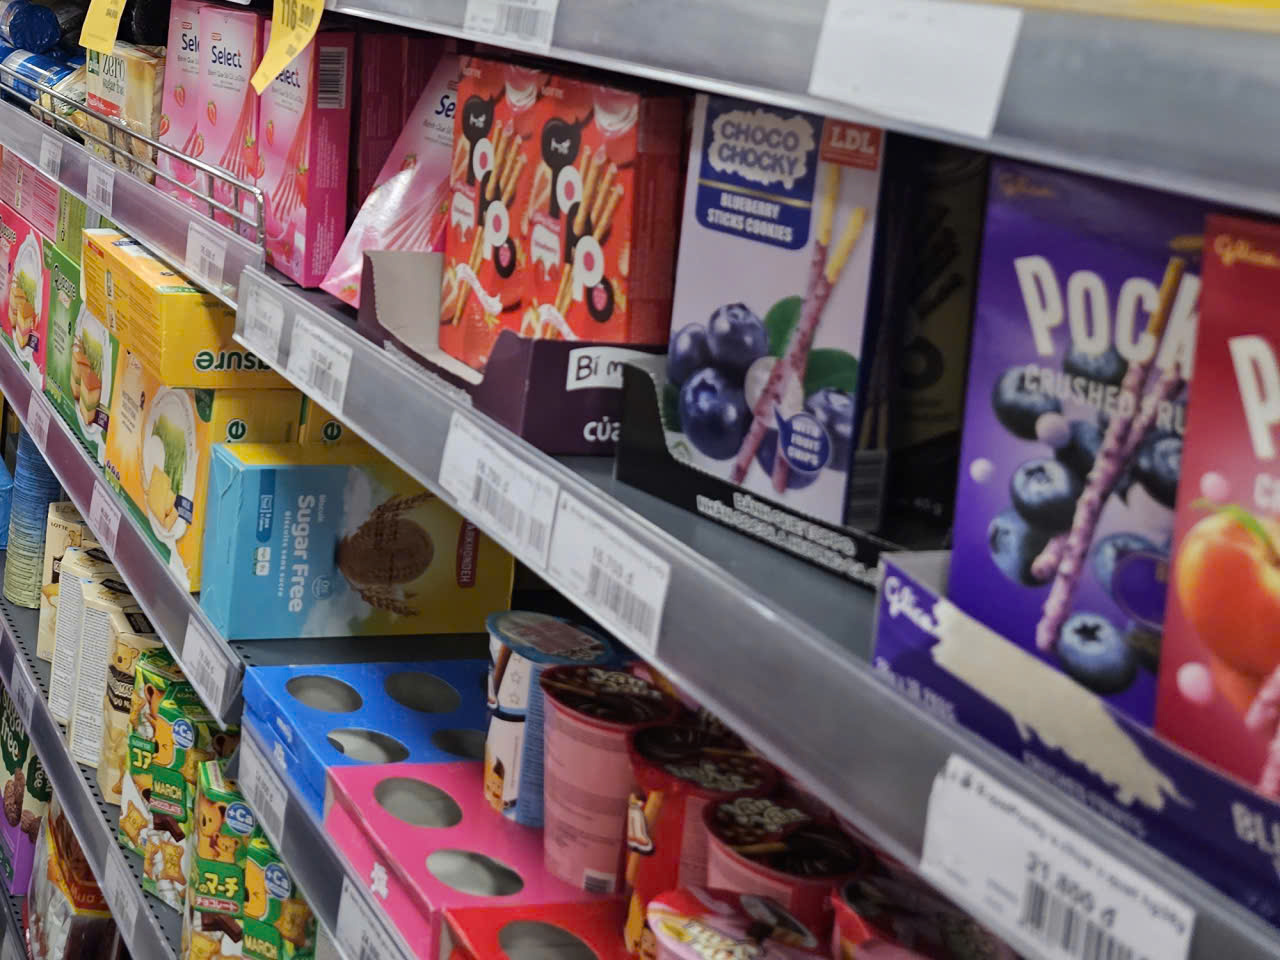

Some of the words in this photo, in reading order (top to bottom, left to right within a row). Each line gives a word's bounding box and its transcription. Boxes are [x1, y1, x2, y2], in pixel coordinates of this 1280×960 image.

[181, 33, 199, 52] Sel
[103, 54, 126, 81] zero
[211, 45, 242, 69] Select
[721, 120, 800, 153] CHOCO
[831, 126, 876, 154] LDL
[718, 142, 800, 176] CHOCKY
[720, 192, 781, 220] BLUEBERRY
[745, 217, 794, 243] COOKIES
[53, 263, 76, 300] Quasure
[1014, 254, 1202, 382] POCK
[194, 350, 272, 372] asure
[291, 495, 315, 561] Sugar
[288, 563, 309, 613] Free
[0, 724, 19, 761] free
[133, 748, 153, 769] コア
[153, 780, 183, 800] MARCH
[227, 807, 253, 826] +Ca
